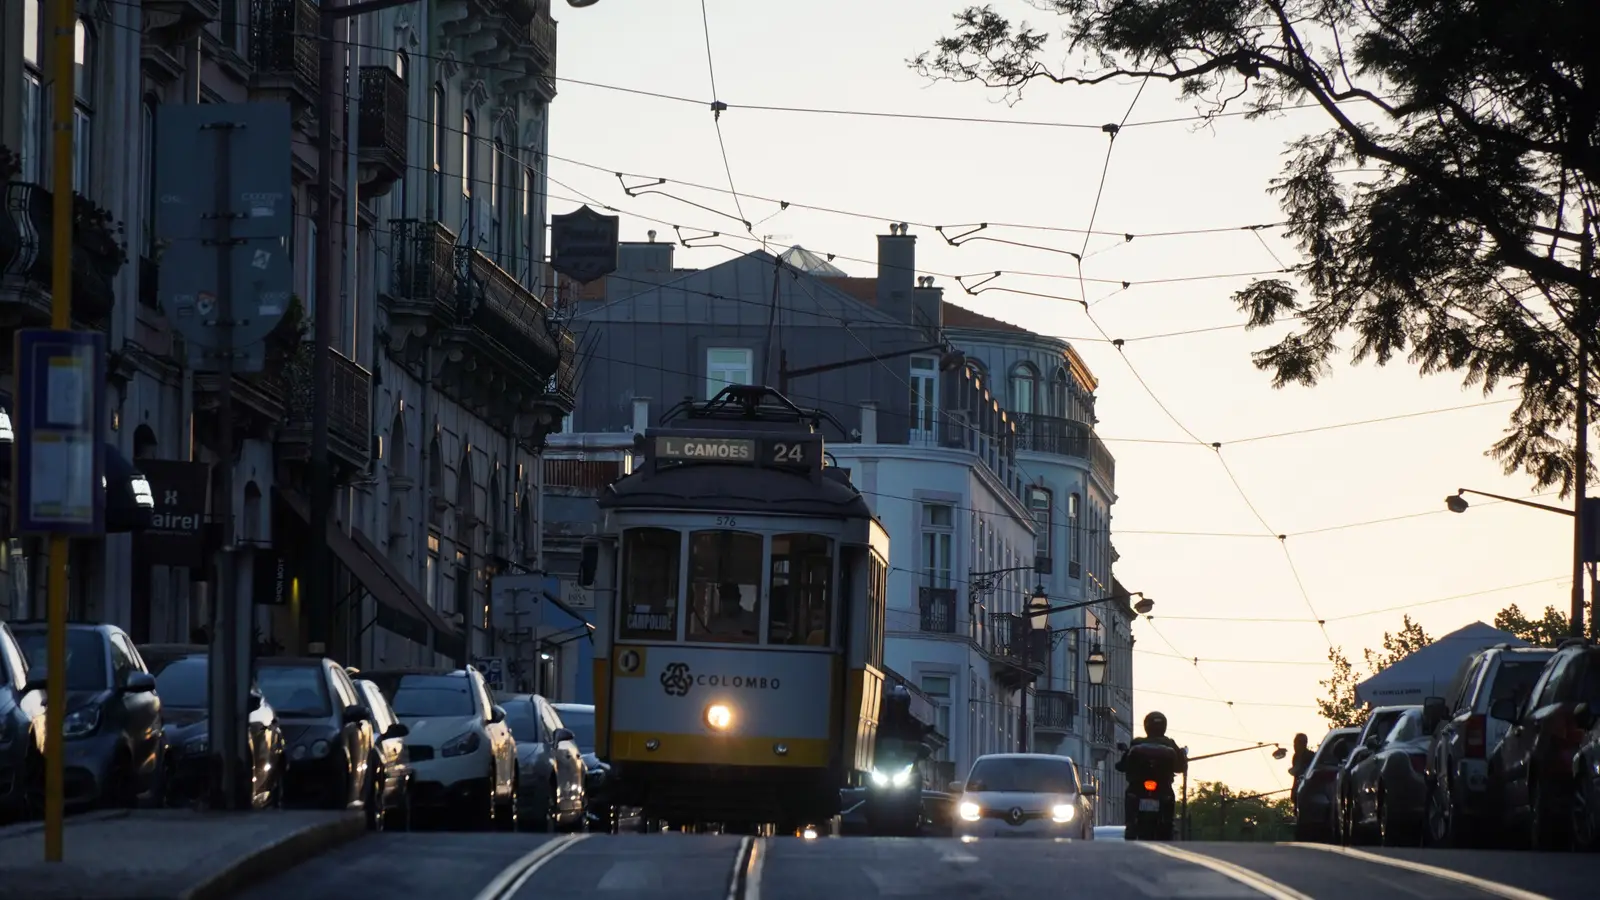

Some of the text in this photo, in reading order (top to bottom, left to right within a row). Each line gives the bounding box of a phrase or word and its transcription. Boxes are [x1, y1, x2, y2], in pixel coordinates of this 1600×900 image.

[665, 441, 680, 455] L.
[773, 443, 804, 463] 24
[716, 516, 736, 527] 576
[627, 613, 672, 631] CAMPOLIDE
[696, 674, 781, 690] COLOMBO
